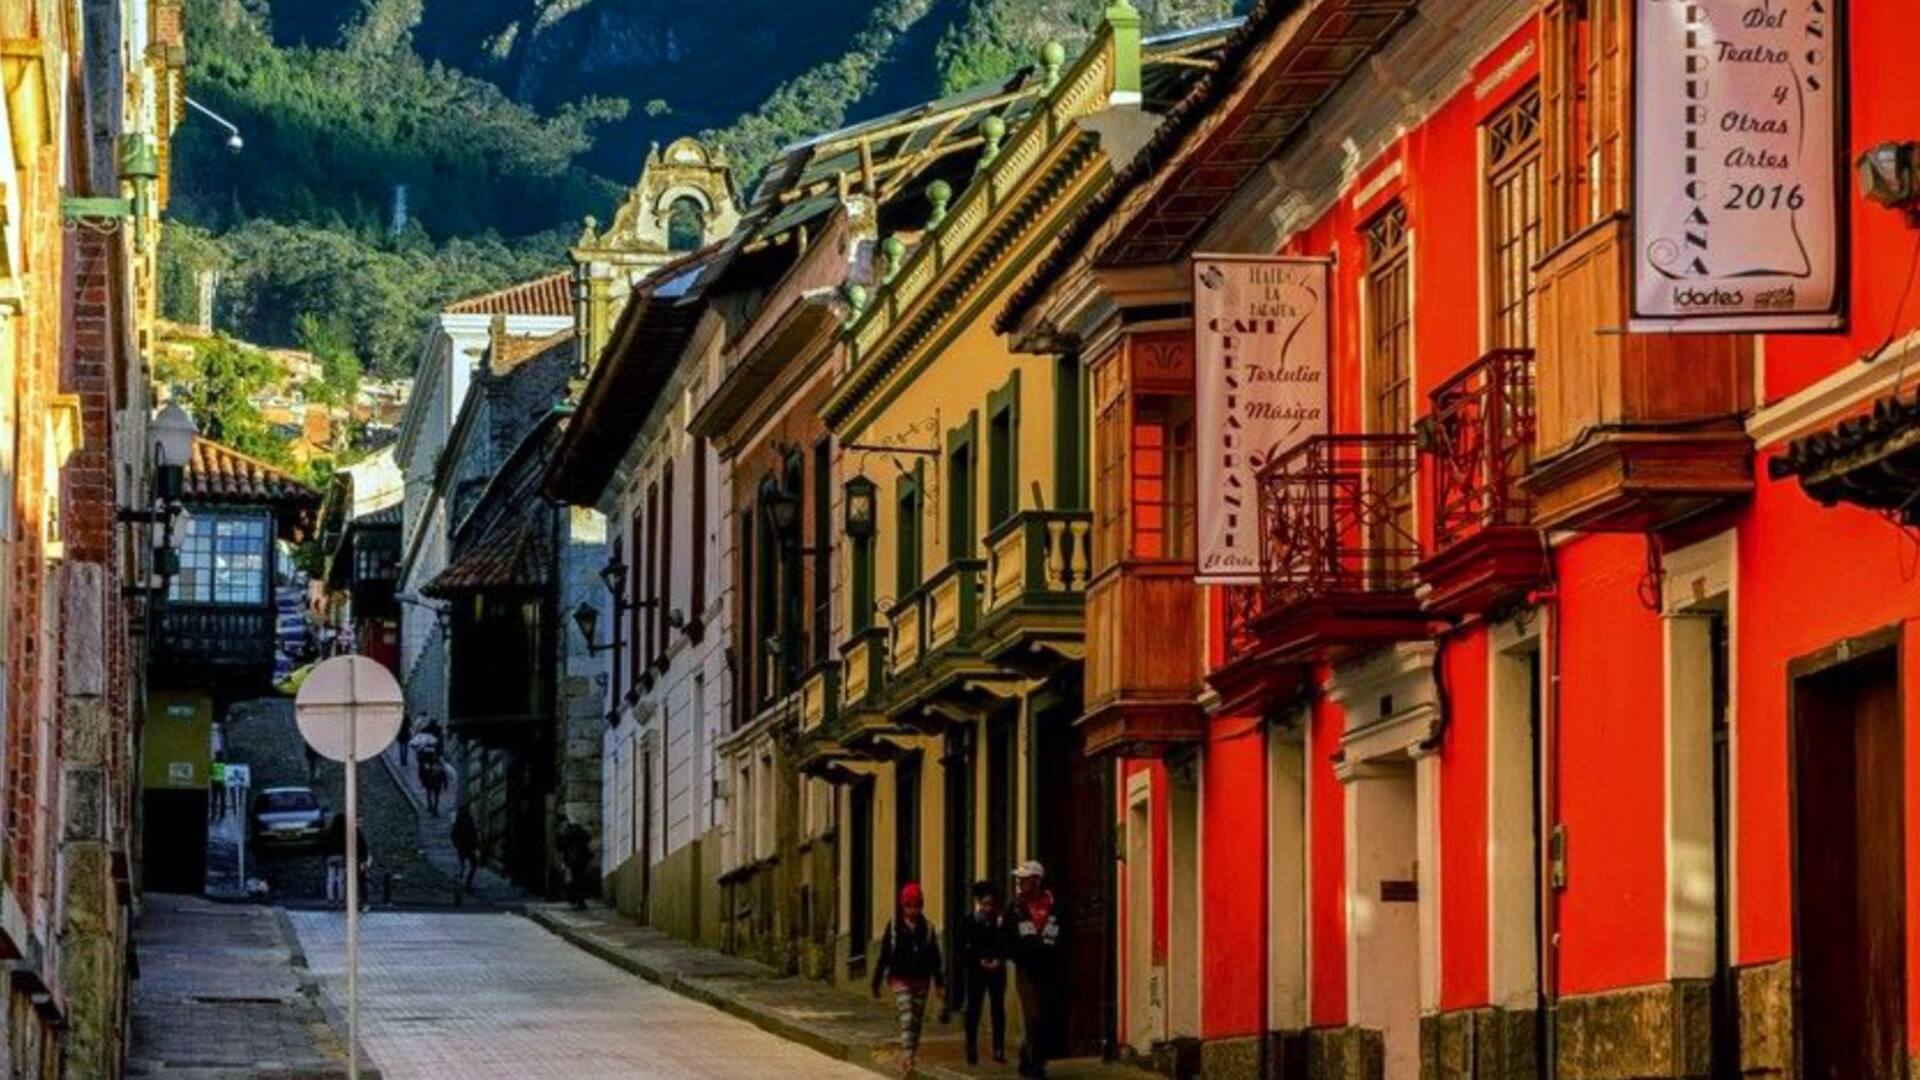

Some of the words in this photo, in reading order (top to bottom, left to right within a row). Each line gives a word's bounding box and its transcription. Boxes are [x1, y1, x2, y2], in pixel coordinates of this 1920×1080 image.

[1742, 8, 1787, 29] Del
[1714, 40, 1788, 63] Teatro
[1773, 85, 1788, 105] y
[1720, 111, 1788, 134] Otras
[1724, 148, 1789, 169] Artes
[1723, 184, 1804, 210] 2016
[1673, 285, 1744, 307] Idartes
[1244, 363, 1321, 383] Tertulia
